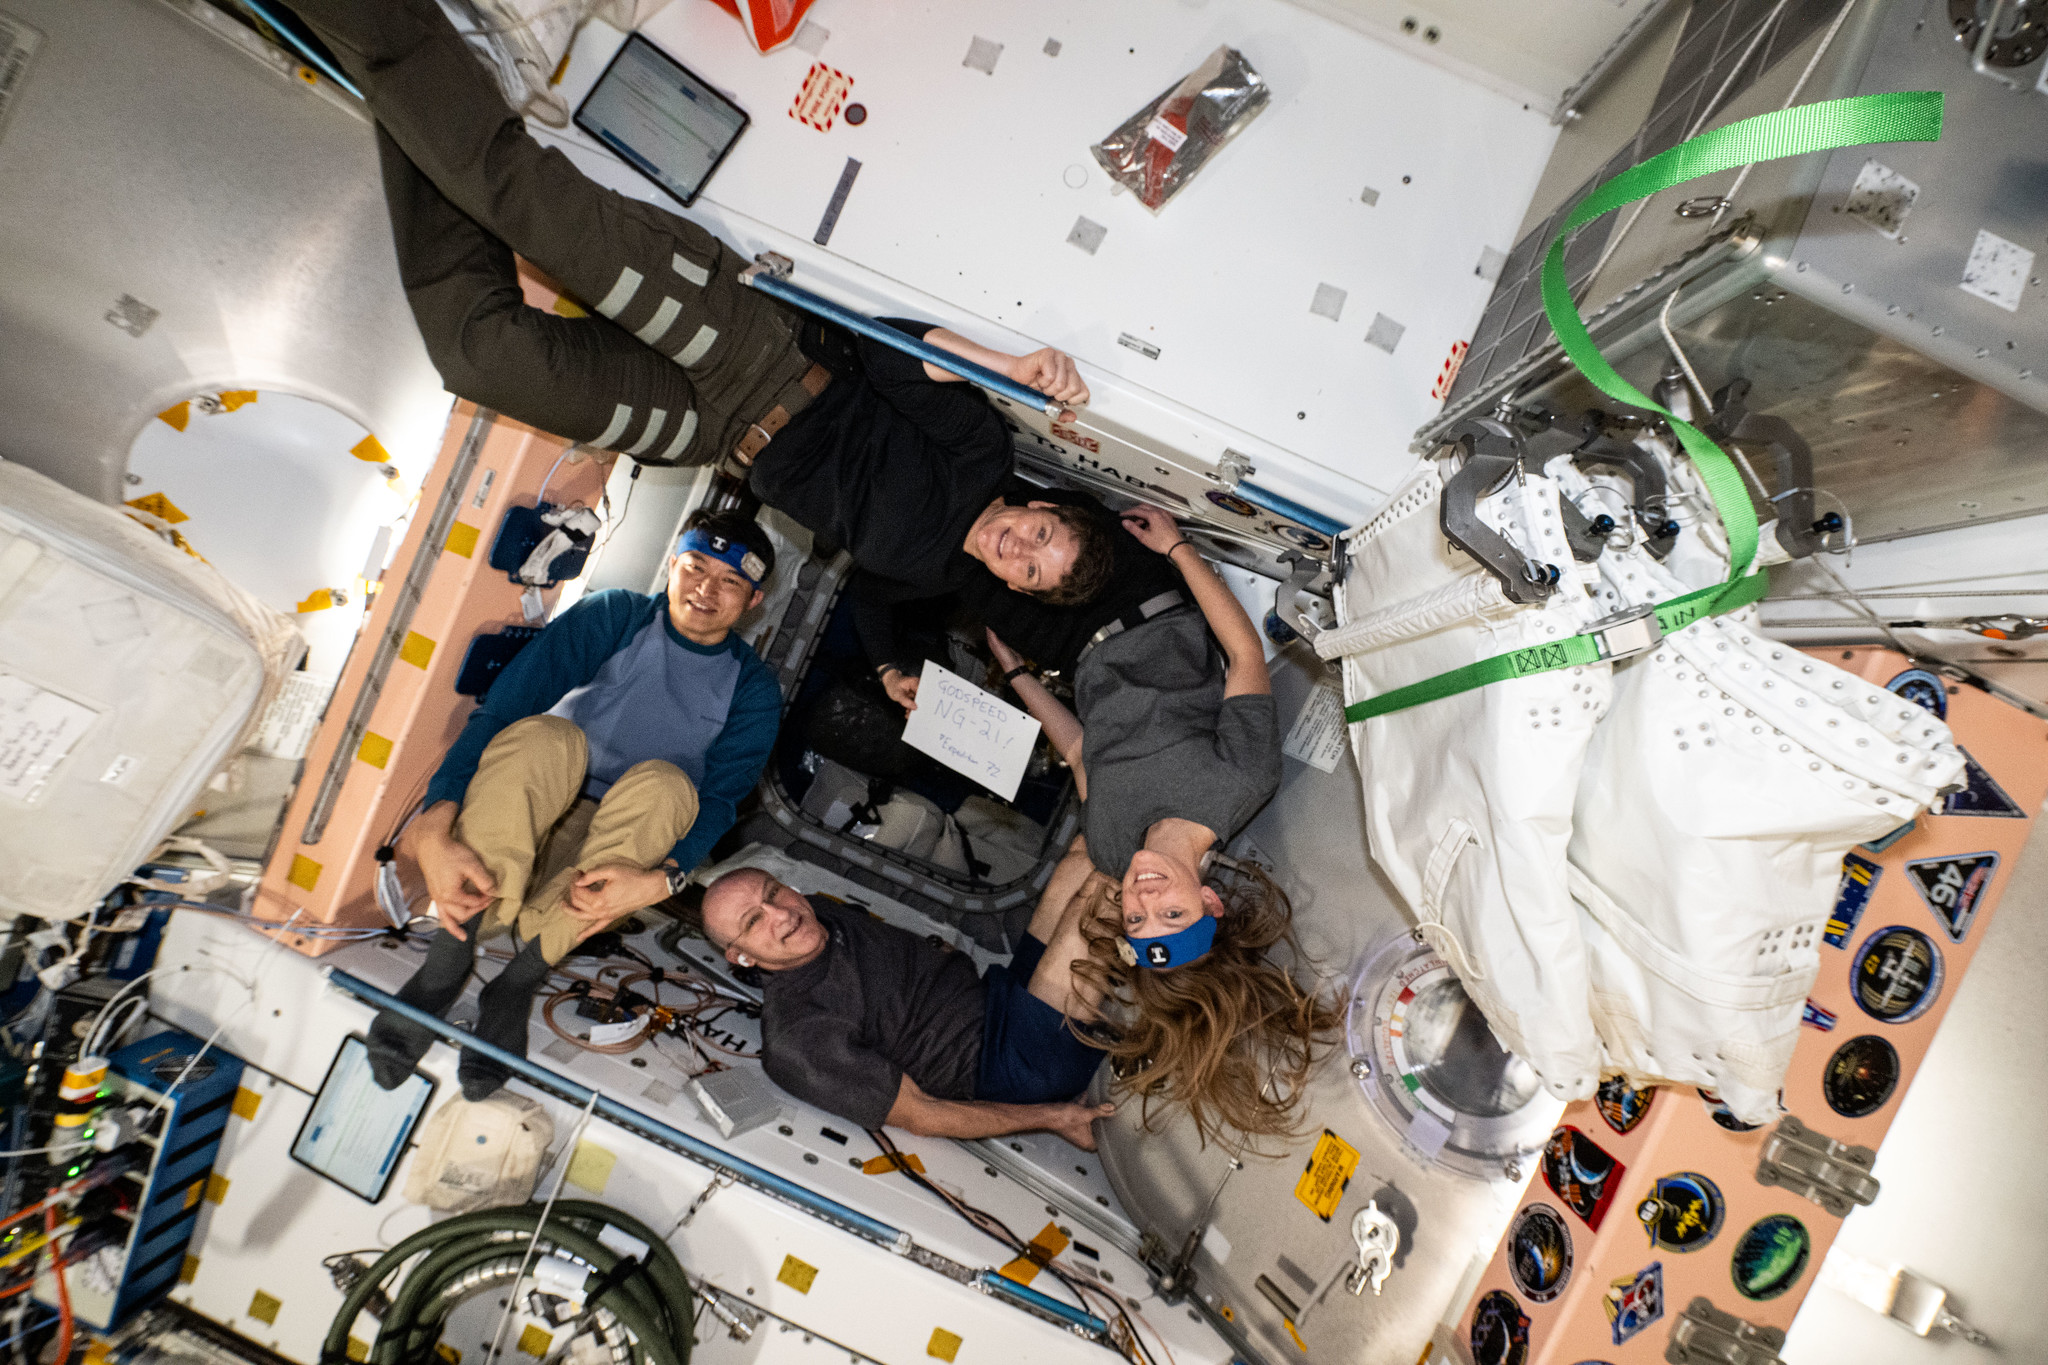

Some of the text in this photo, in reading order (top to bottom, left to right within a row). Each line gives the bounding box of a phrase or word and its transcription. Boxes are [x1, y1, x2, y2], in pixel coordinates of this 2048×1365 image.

[937, 680, 1008, 723] GODSPEED
[986, 761, 1001, 778] 72
[1930, 863, 1965, 908] 46
[697, 1020, 747, 1052] HA
